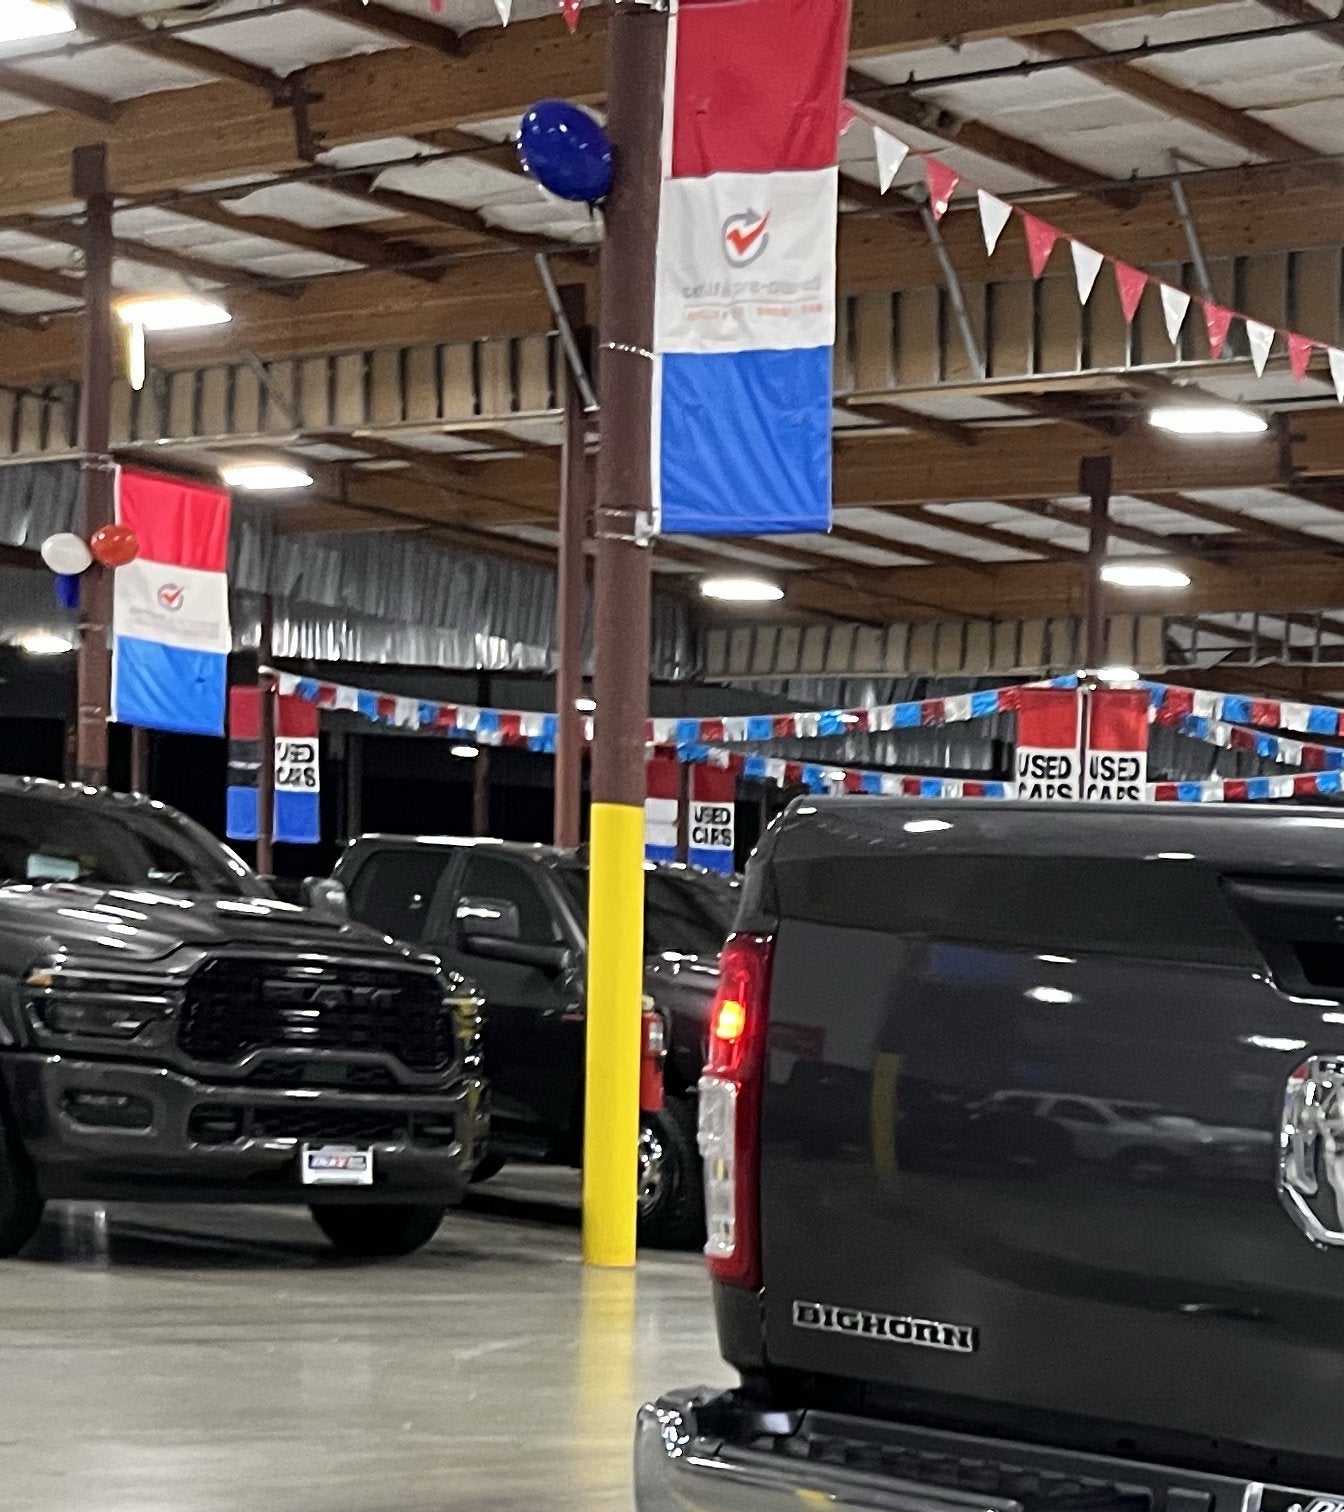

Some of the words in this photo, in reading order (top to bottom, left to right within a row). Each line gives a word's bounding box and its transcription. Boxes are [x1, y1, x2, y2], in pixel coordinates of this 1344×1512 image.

[1019, 754, 1072, 780] USED
[1089, 756, 1140, 781] USED
[793, 1300, 974, 1352] BIGHORN
